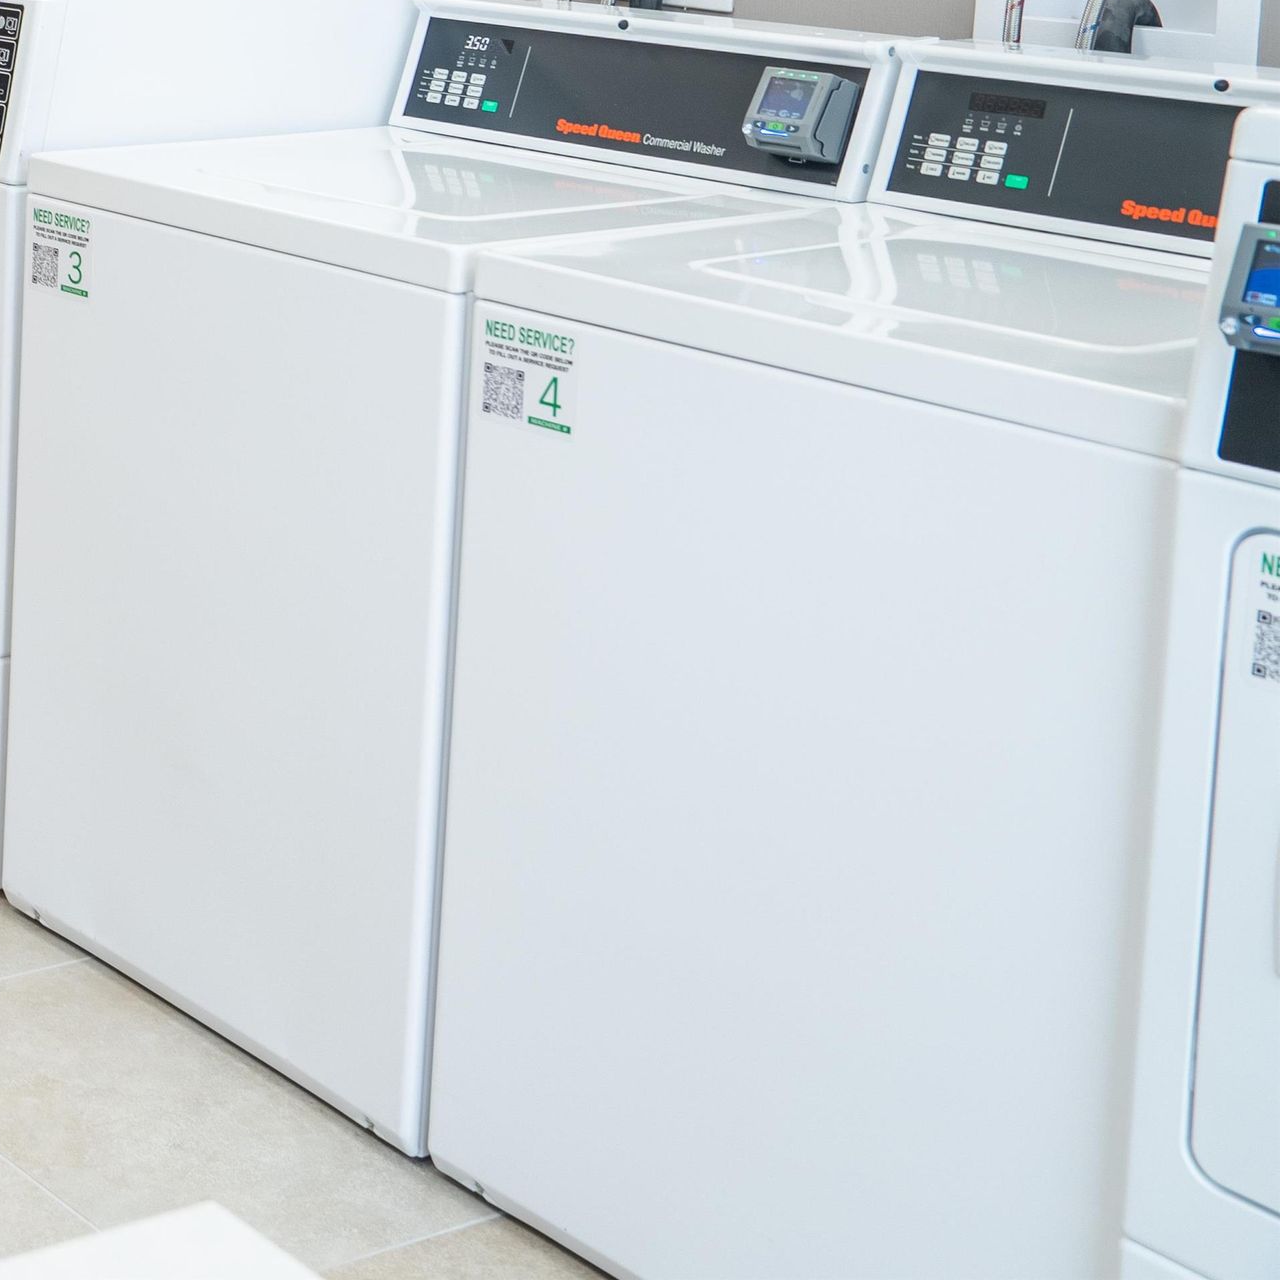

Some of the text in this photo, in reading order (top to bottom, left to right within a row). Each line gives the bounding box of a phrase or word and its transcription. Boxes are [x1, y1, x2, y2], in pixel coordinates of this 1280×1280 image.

[555, 118, 726, 157] Speed Queen Commercial Washer
[33, 208, 91, 234] NEED SERVICE?
[1120, 199, 1187, 223] Speed
[67, 251, 83, 285] 3
[485, 319, 575, 355] NEED SERVICE?
[539, 376, 561, 417] 4
